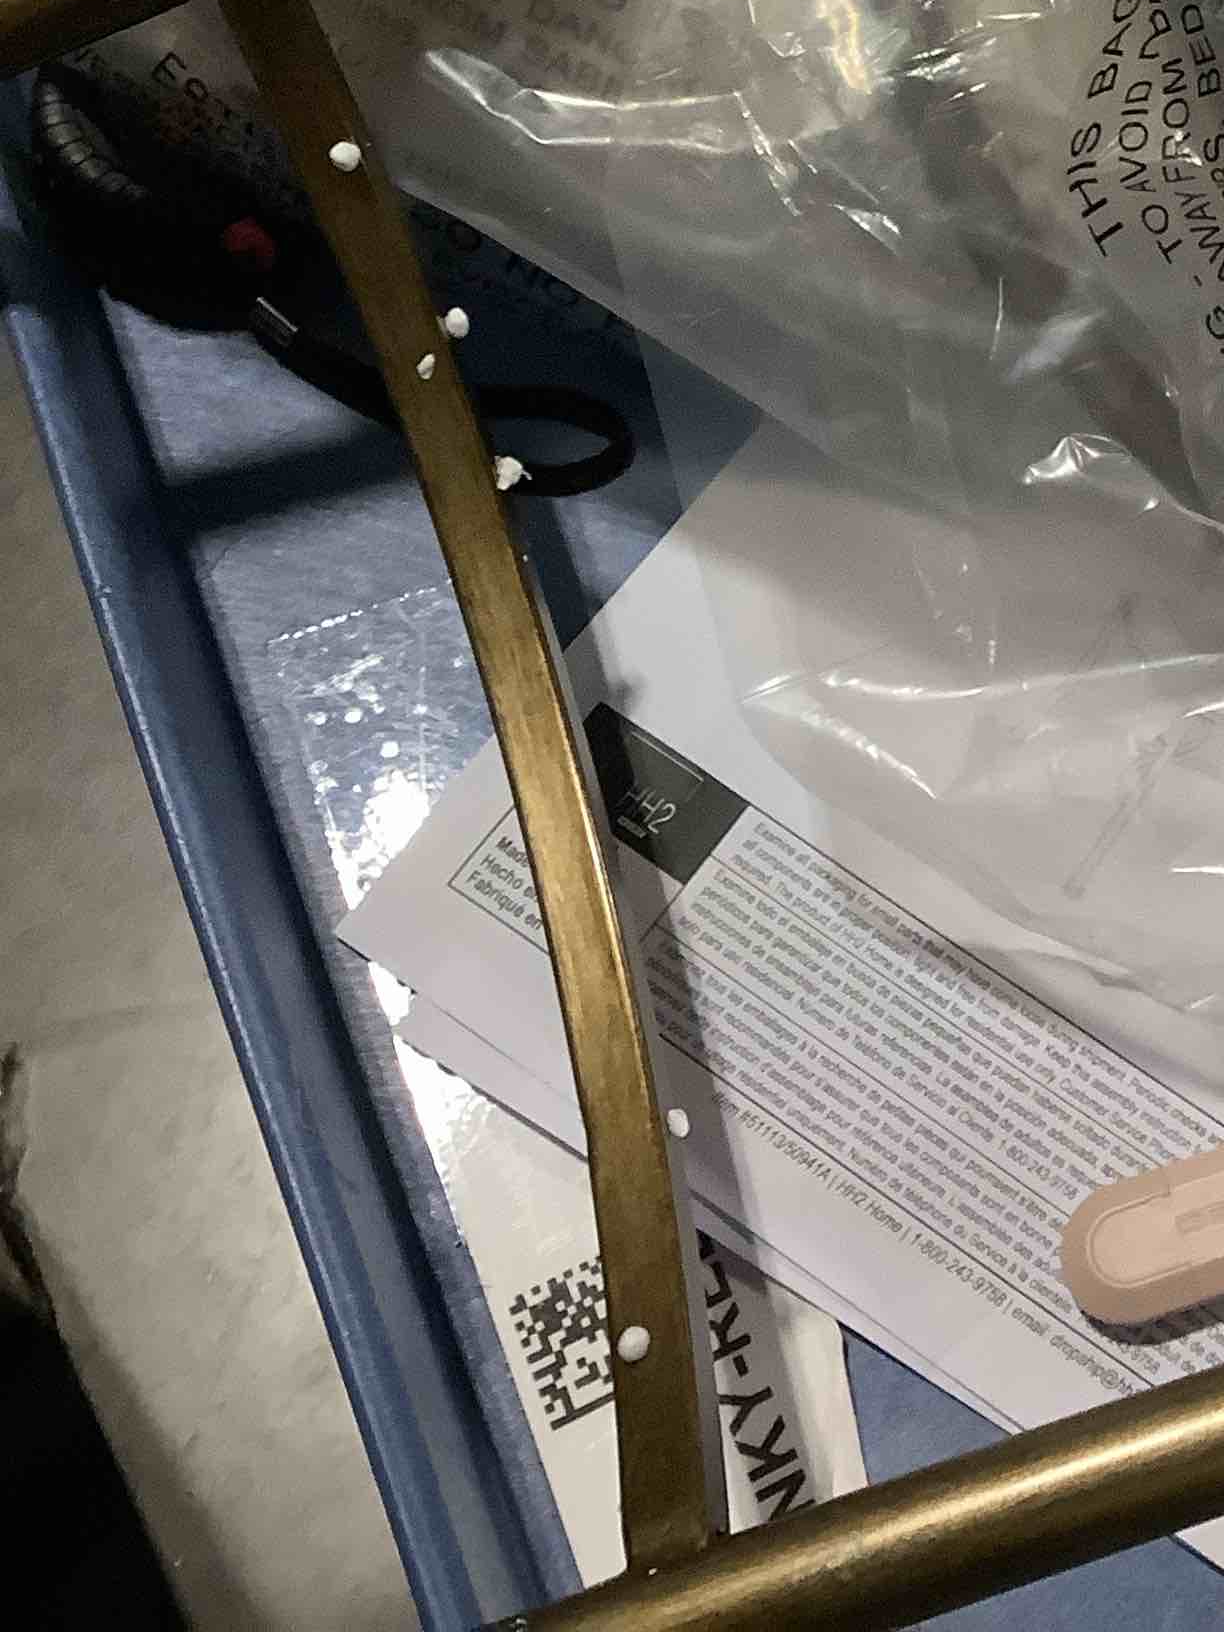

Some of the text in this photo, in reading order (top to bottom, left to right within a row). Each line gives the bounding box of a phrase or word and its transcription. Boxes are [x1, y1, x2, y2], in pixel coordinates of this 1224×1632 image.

[1117, 80, 1156, 192] AVOID
[1161, 57, 1197, 184] FROM
[1067, 121, 1124, 257] THIS
[1141, 203, 1183, 264] TO
[479, 854, 524, 890] Hecho
